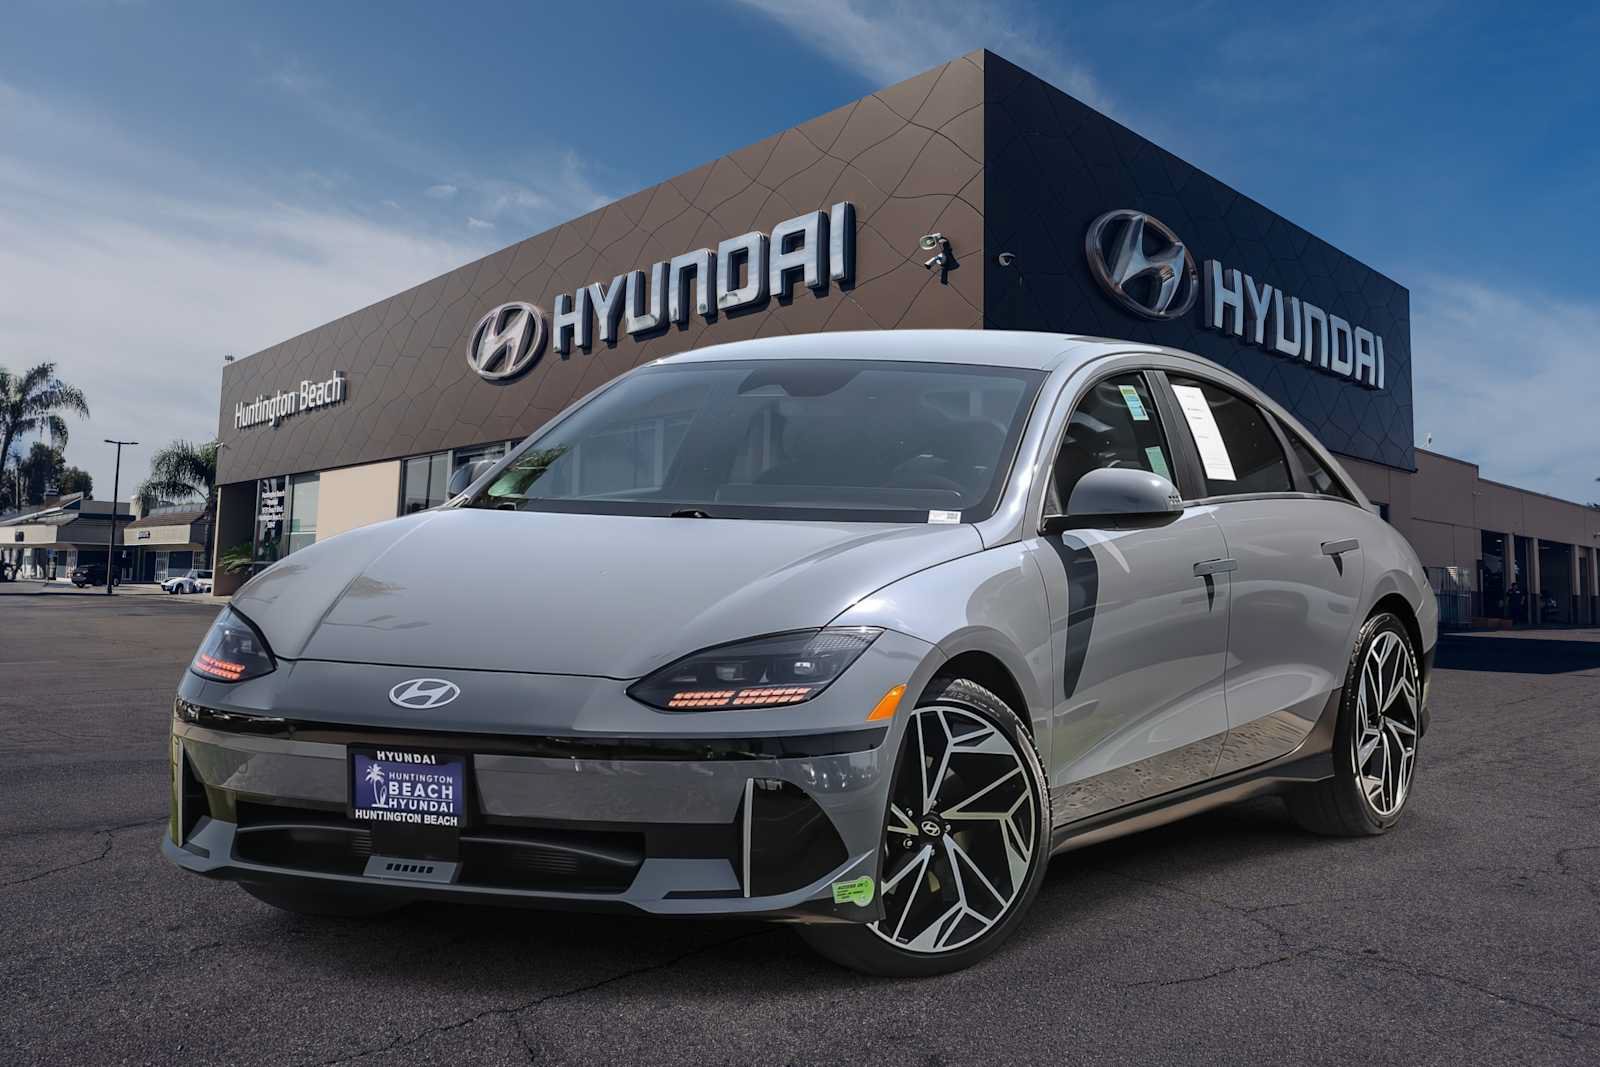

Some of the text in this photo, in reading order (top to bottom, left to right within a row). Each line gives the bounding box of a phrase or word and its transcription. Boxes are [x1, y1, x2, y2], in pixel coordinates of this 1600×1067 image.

[553, 201, 849, 353] HYUNDAI
[1206, 259, 1385, 389] HYUNDAI
[234, 370, 343, 428] Huntington Beach
[376, 750, 436, 765] HYUNDAI
[388, 771, 453, 784] HUNTINGTON
[388, 781, 453, 799] BEACH
[388, 798, 453, 813] HYUNDAI
[355, 810, 458, 827] HUNTINGTON BEACH
